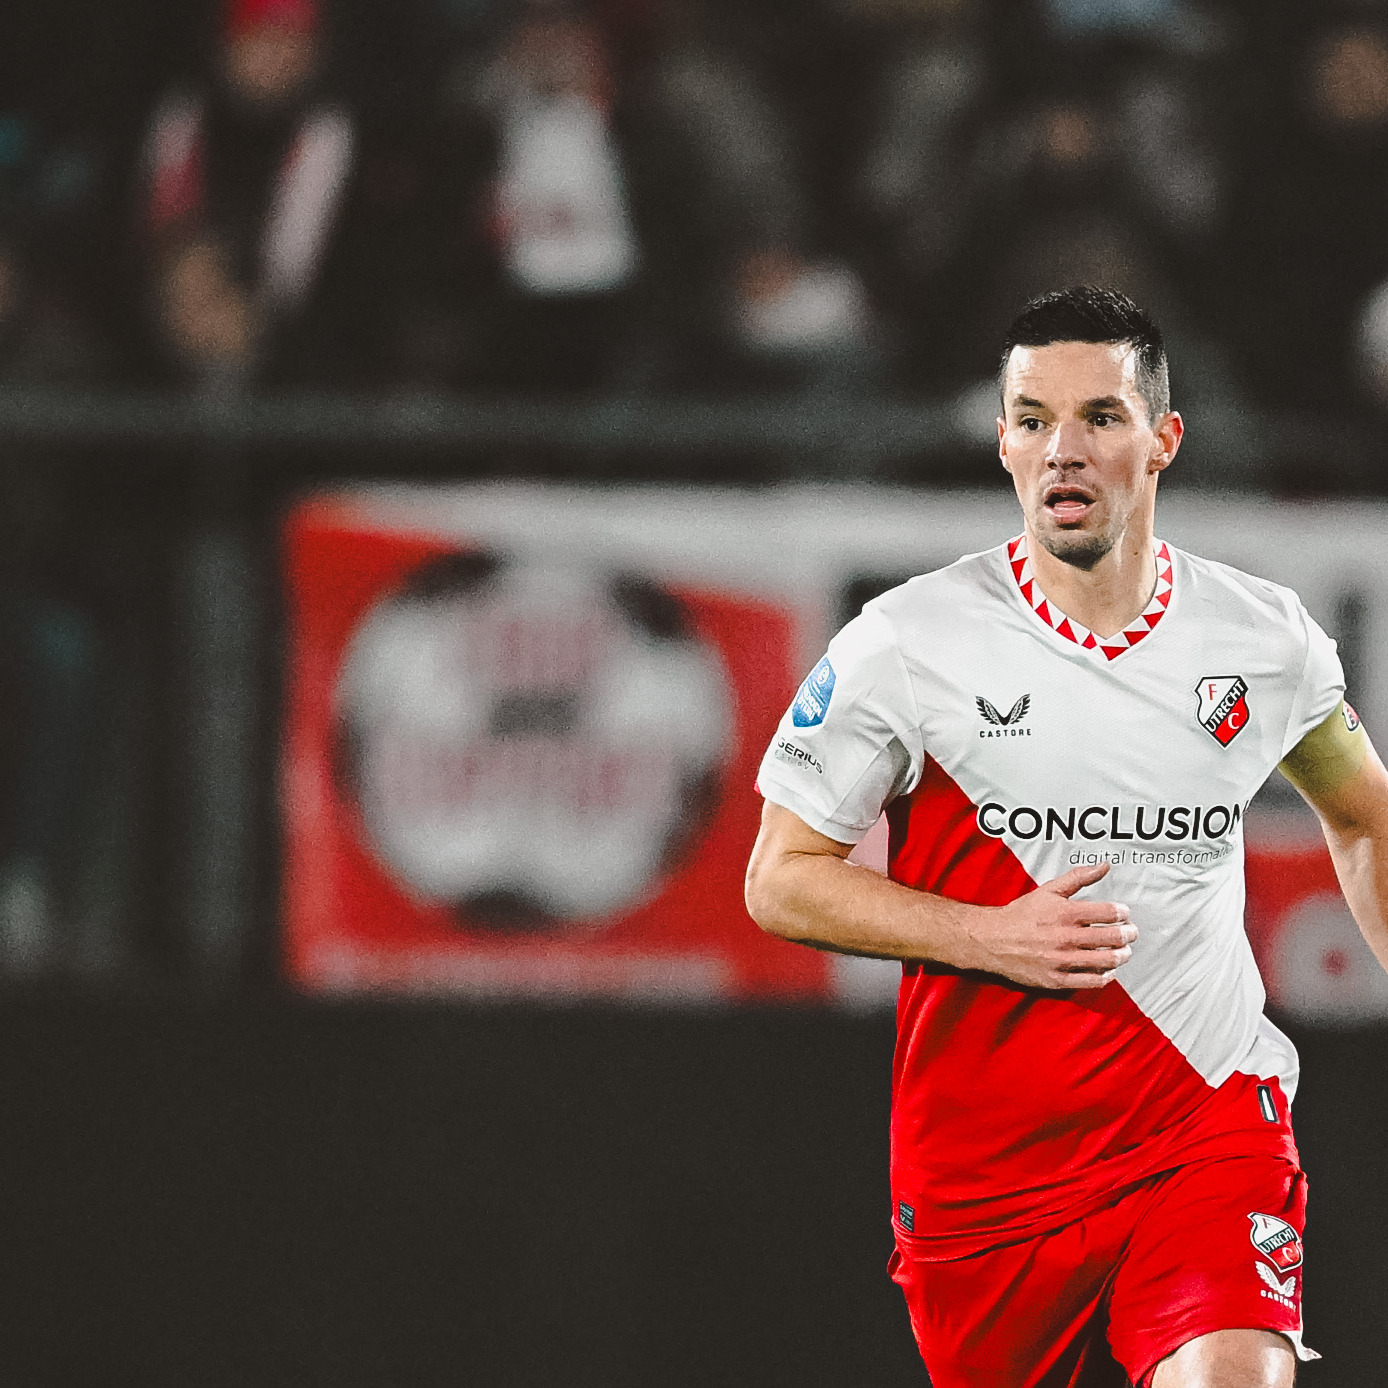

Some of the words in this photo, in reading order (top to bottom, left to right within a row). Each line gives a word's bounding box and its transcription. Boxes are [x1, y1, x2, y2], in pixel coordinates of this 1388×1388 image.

[1208, 683, 1218, 701] F
[1205, 680, 1245, 733] UTRECHT
[1227, 712, 1240, 730] C
[979, 728, 1032, 738] CASTORE
[978, 800, 1249, 841] CONCLUSION
[1069, 849, 1126, 866] digital
[1259, 1228, 1295, 1254] UTRECHT
[1282, 1247, 1293, 1262] C
